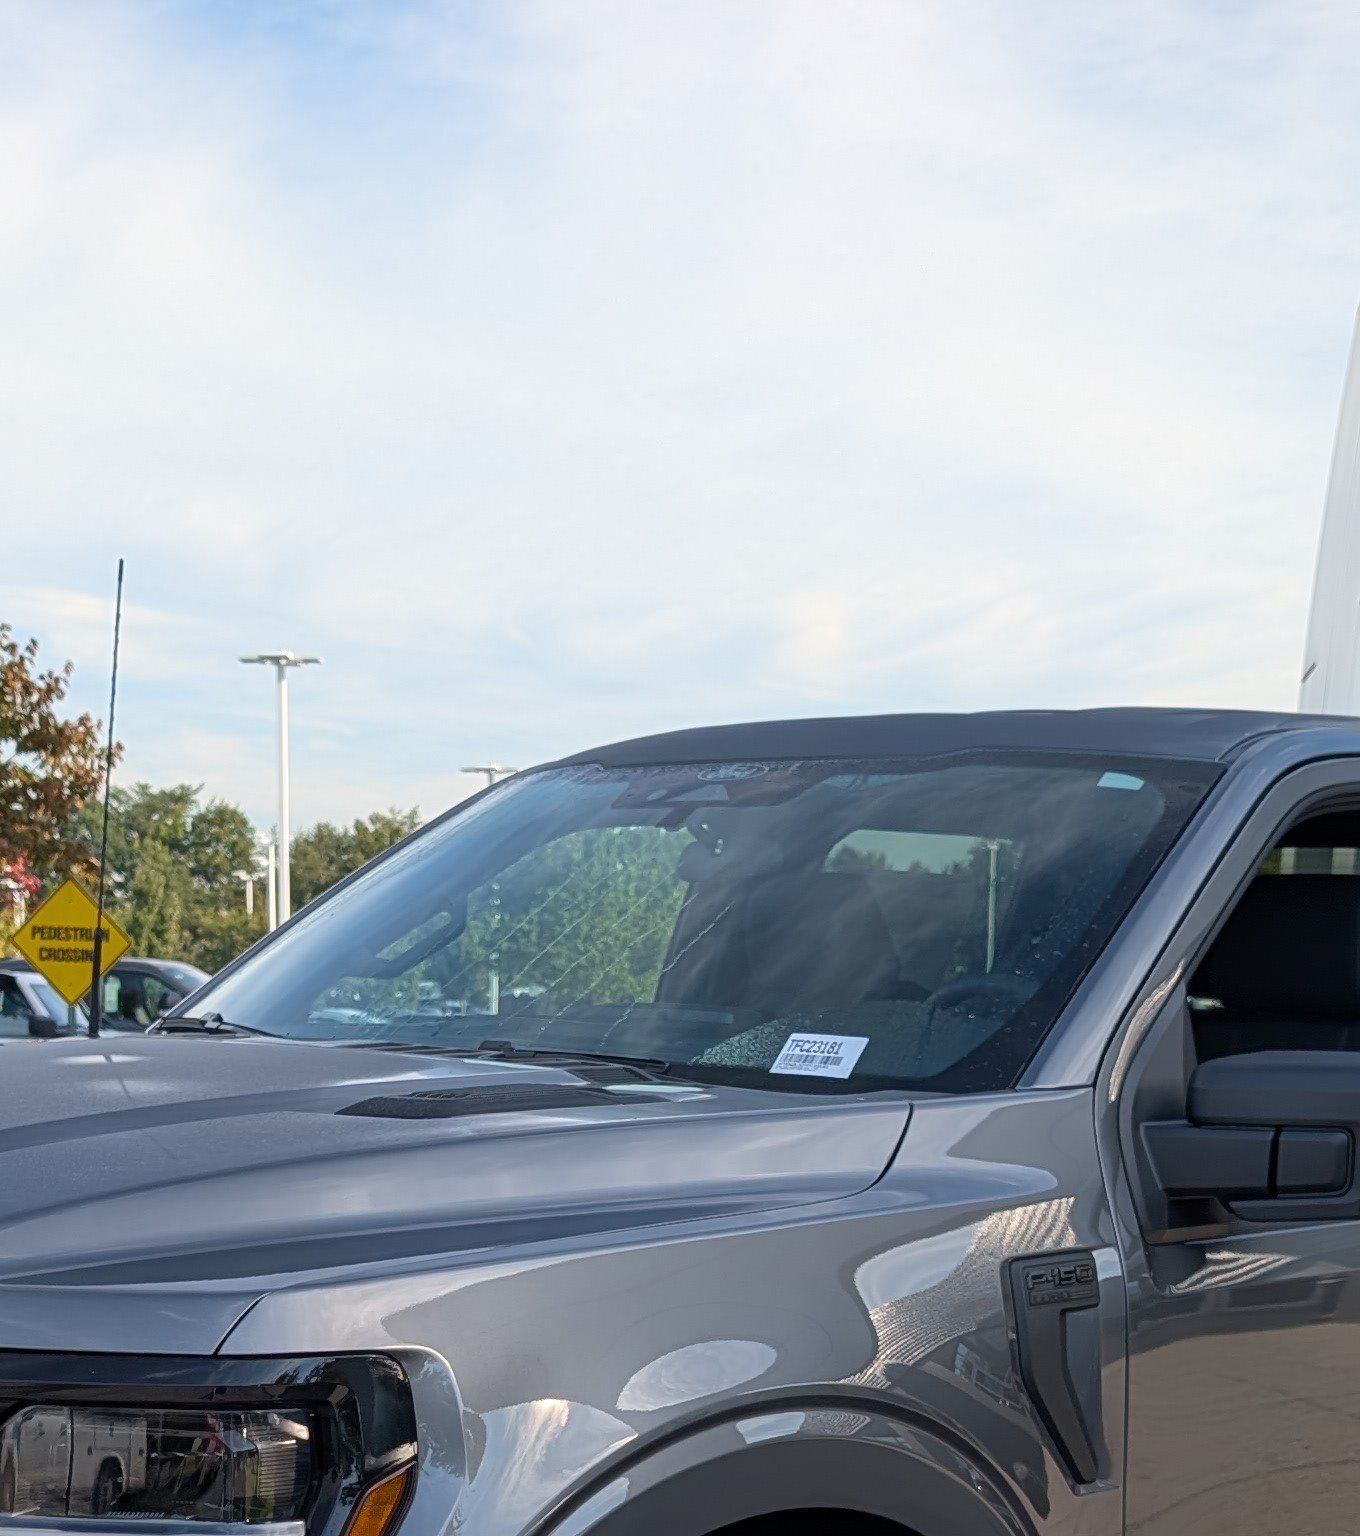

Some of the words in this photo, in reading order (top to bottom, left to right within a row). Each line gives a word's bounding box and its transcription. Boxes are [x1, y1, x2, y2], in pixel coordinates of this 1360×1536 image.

[31, 926, 110, 942] PEDESTRIN
[39, 947, 97, 963] CROSSIN
[786, 1038, 844, 1055] TFC23181
[1024, 1263, 1095, 1290] F-150
